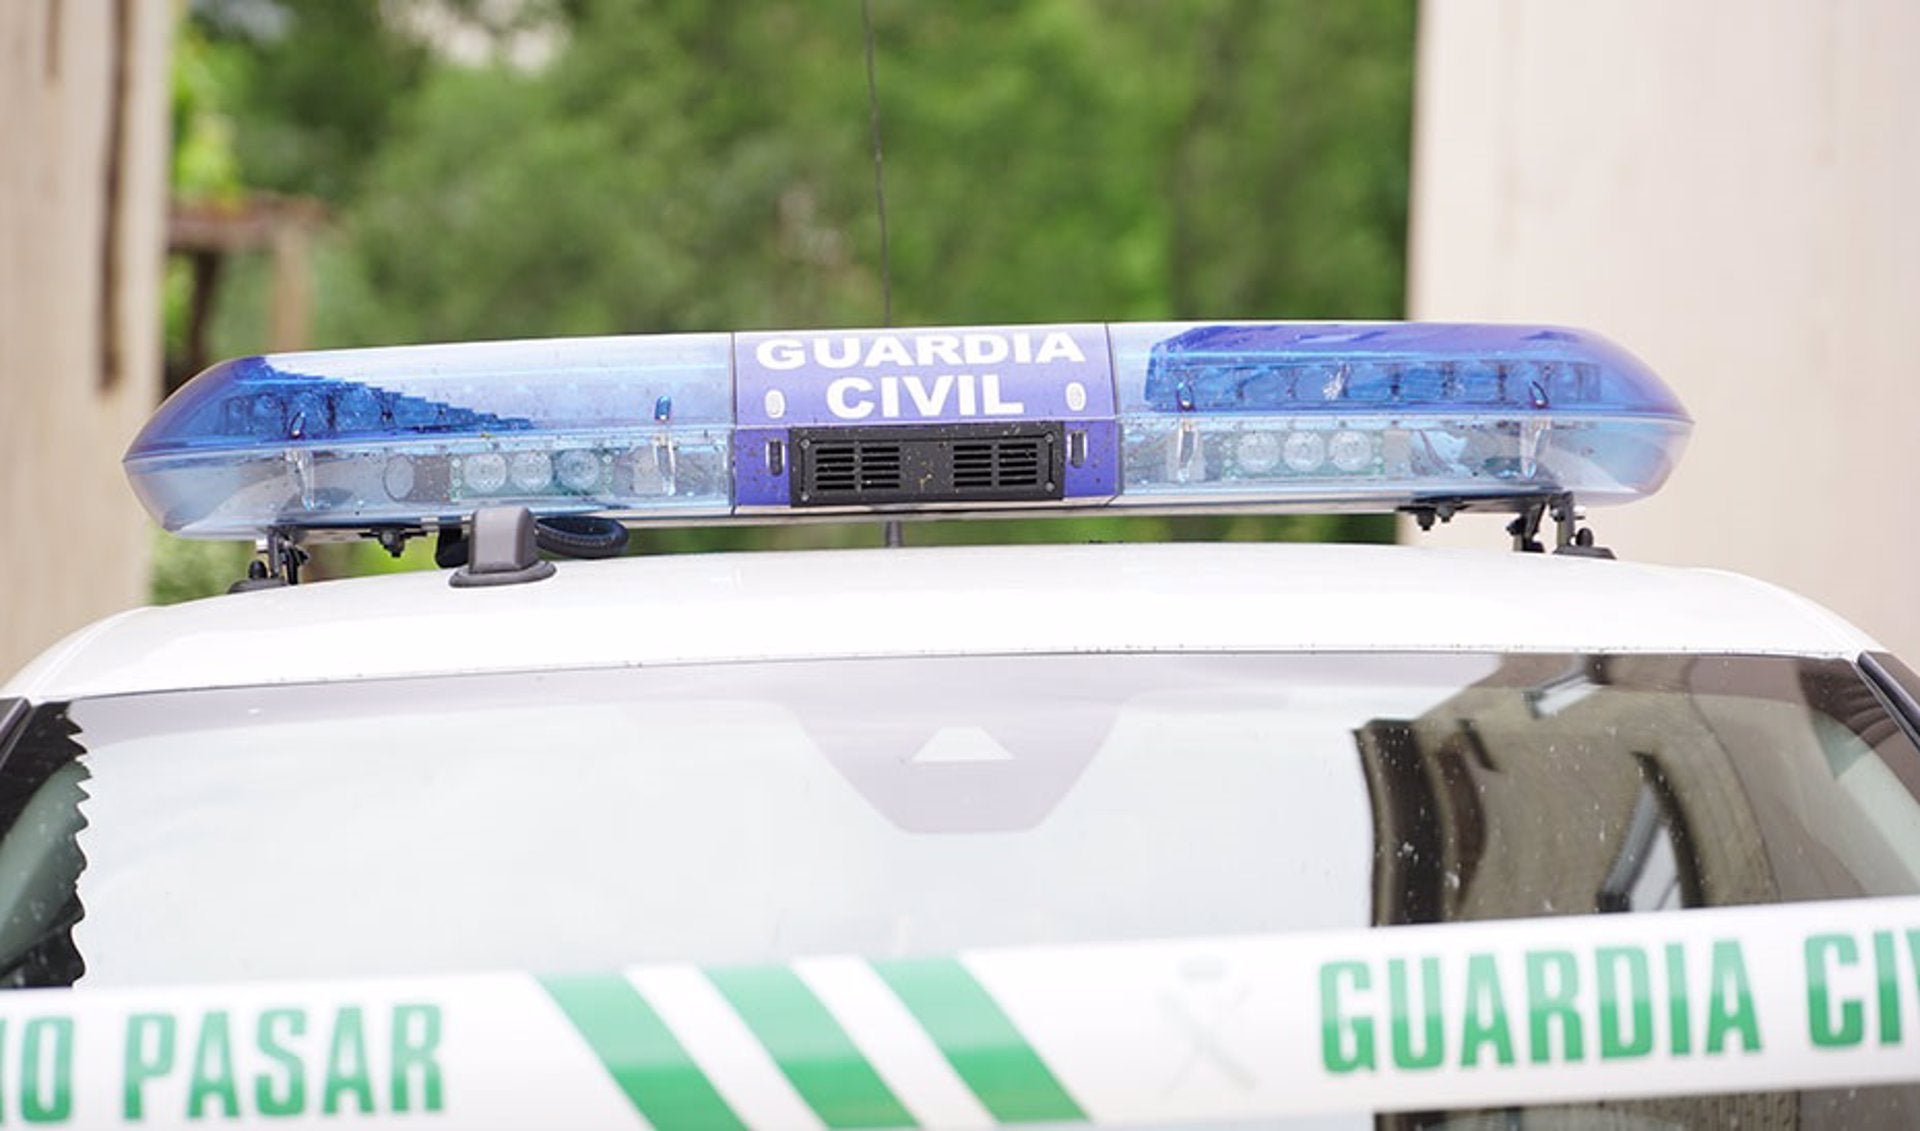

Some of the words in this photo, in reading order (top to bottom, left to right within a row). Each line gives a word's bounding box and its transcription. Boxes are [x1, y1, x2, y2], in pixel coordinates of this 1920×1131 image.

[756, 331, 1086, 370] GUARDIA
[826, 374, 1025, 419] CIVIL
[1319, 940, 1763, 1074] GUARDIA
[0, 1016, 75, 1123] O
[123, 1003, 443, 1120] PASAR
